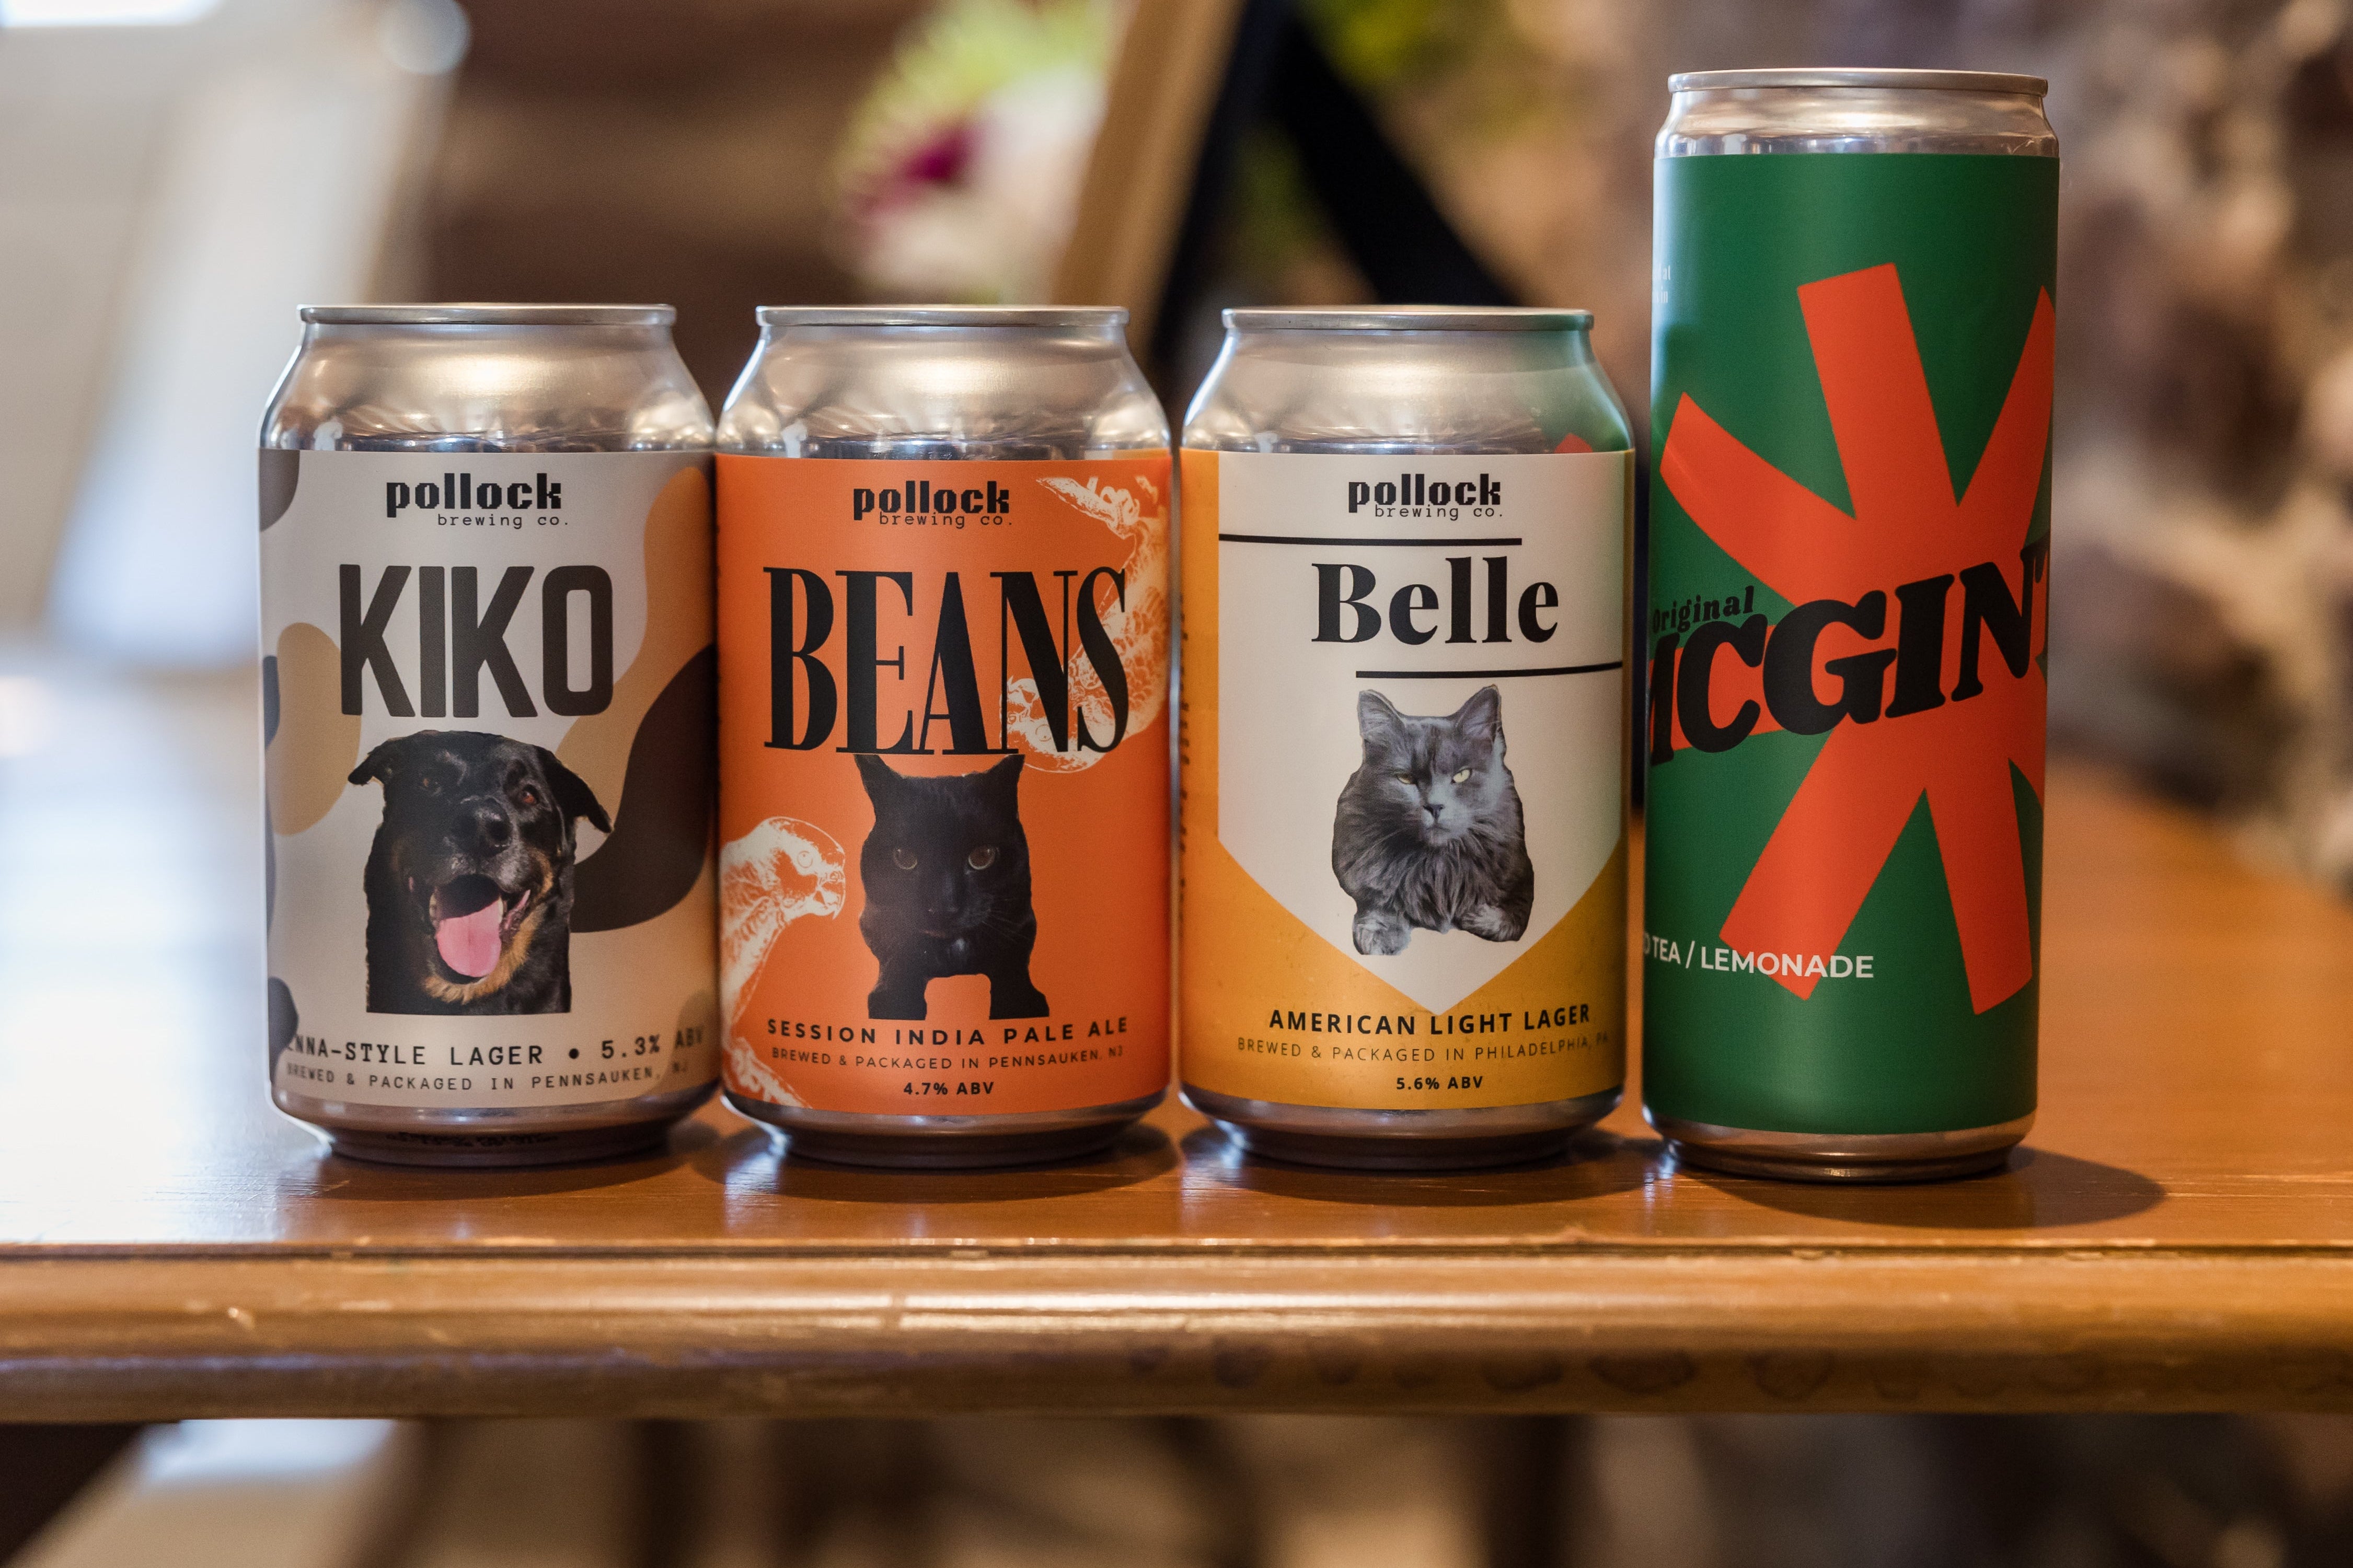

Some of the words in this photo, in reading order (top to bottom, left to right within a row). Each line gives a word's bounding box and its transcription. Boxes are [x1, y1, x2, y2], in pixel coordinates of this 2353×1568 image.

[387, 472, 562, 518] pollock
[853, 480, 1010, 520] pollock
[1349, 473, 1501, 513] pollock
[437, 514, 523, 530] brewing
[537, 516, 568, 526] co.
[879, 511, 965, 529] brewing
[980, 515, 1012, 526] co.
[1375, 504, 1459, 521] brewing
[1473, 507, 1503, 518] co.
[1311, 555, 1559, 645] Belle
[340, 564, 615, 717] KIKO
[764, 566, 1129, 755] BEANS
[1653, 935, 1681, 964] TEA
[1702, 946, 1874, 978] LEMONADE
[768, 1018, 876, 1044] SESSION
[896, 1029, 985, 1046] INDIA
[1004, 1023, 1074, 1044] PALE
[1088, 1016, 1127, 1038] ALE
[1268, 1009, 1415, 1036] AMERICAN
[1431, 1013, 1513, 1036] LIGHT
[1524, 1003, 1589, 1031] LAGER
[451, 1044, 543, 1066] LAGER
[602, 1034, 660, 1059] 5.3%
[772, 1047, 832, 1065] BREWED
[838, 1054, 848, 1066] &
[856, 1056, 952, 1070] PACKAGED
[961, 1058, 979, 1069] IN
[1237, 1037, 1301, 1058] BREWED
[1311, 1046, 1322, 1059] &
[1333, 1047, 1435, 1062] PACKAGED
[1446, 1048, 1464, 1062] IN
[346, 1073, 355, 1085] &
[369, 1074, 472, 1091] PACKAGED
[491, 1077, 514, 1090] IN
[903, 1081, 949, 1096] 4.7%
[956, 1081, 995, 1096] ABV
[1396, 1077, 1440, 1090] 5.6%
[1447, 1076, 1484, 1090] ABV
